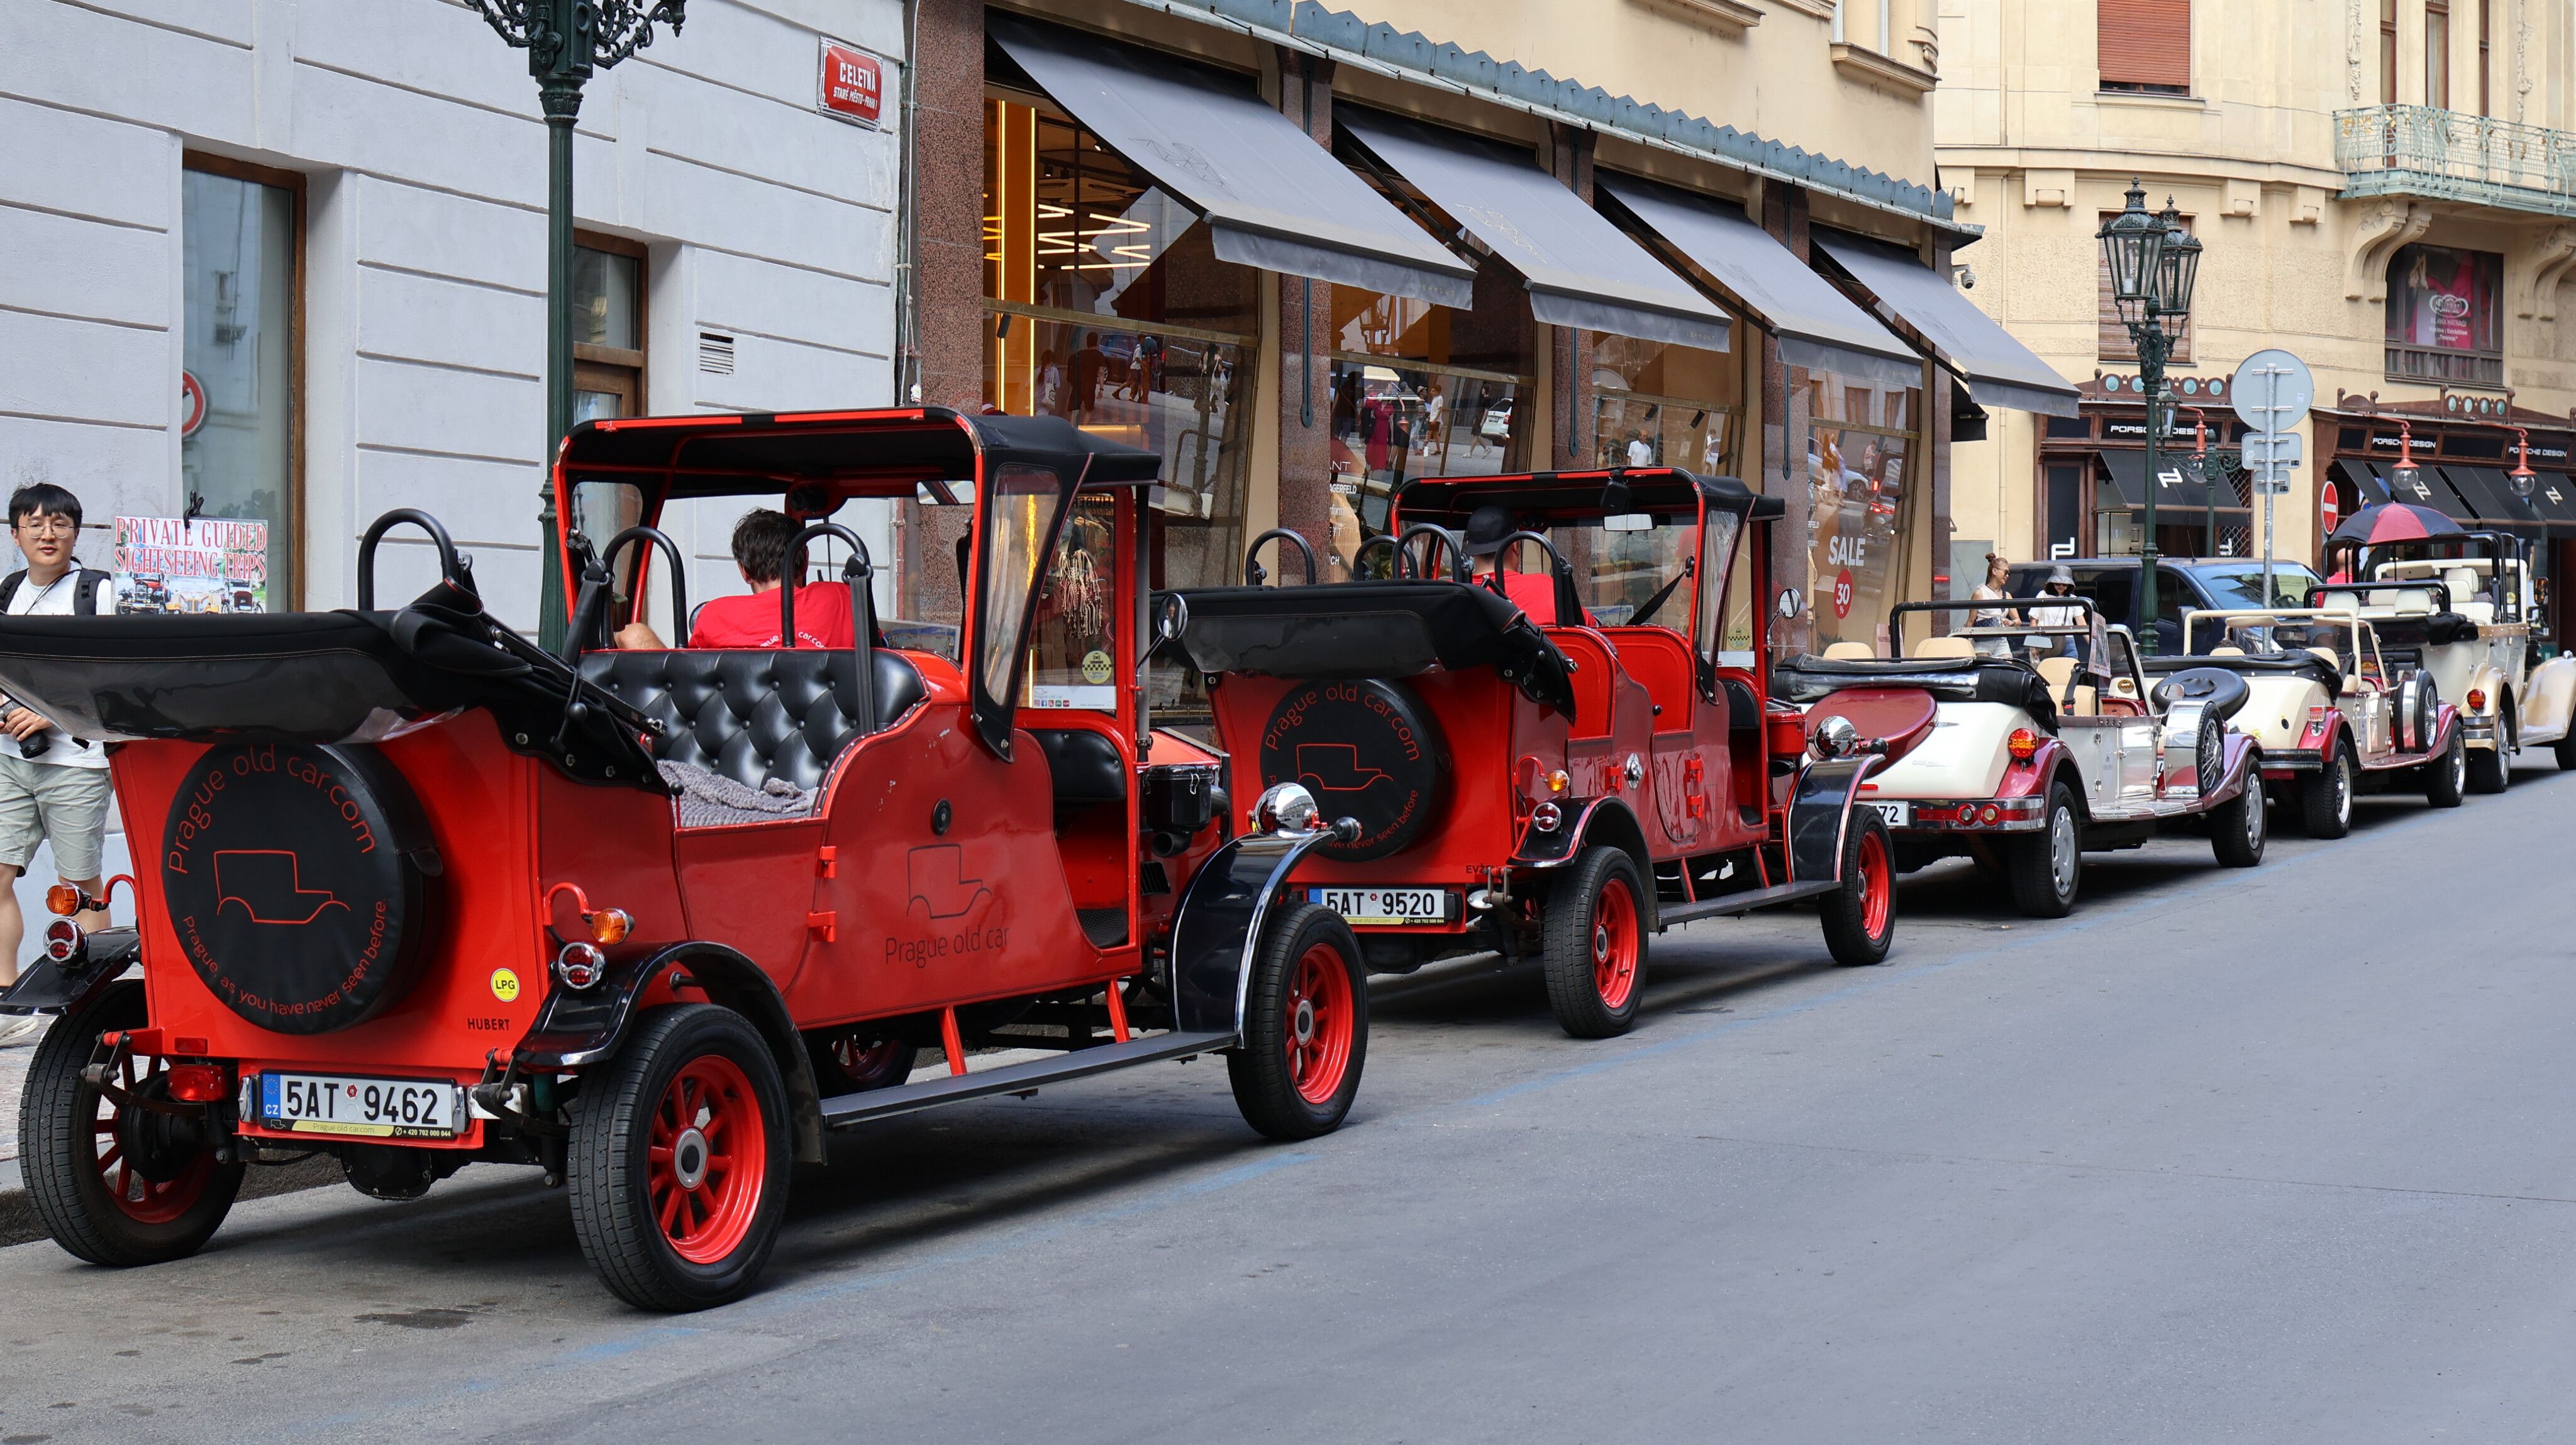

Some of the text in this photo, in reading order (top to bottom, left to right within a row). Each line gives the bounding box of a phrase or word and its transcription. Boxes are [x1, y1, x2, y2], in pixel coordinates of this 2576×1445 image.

[840, 62, 876, 92] CELETNÁ
[833, 86, 849, 100] STARÉ
[2372, 438, 2402, 446] PORSCH
[2509, 446, 2567, 457] POSCHE DESIGN
[1330, 460, 1351, 471] NT
[116, 518, 267, 551] PRIVATE GUIDED
[1828, 535, 1866, 566] SALE
[114, 546, 266, 580] SIGHTSEEING TRIPS
[1836, 584, 1850, 605] 30
[1840, 606, 1845, 614] %
[1266, 683, 1419, 761] Prague old car.com
[169, 745, 375, 873] Prague old car.com
[1348, 838, 1374, 848] never
[1377, 822, 1399, 841] seen
[1327, 892, 1435, 915] 5AT 9520
[886, 924, 1009, 968] Prague old car
[221, 977, 236, 994] as
[238, 989, 266, 1010] you
[270, 998, 304, 1014] have
[307, 990, 341, 1013] never
[342, 958, 370, 993] seen
[495, 980, 515, 990] LPG
[467, 1017, 510, 1031] HUBERT
[265, 1105, 279, 1115] CZ
[287, 1081, 438, 1124] 5AT 9462
[313, 1123, 336, 1132] Prague
[338, 1124, 348, 1132] old
